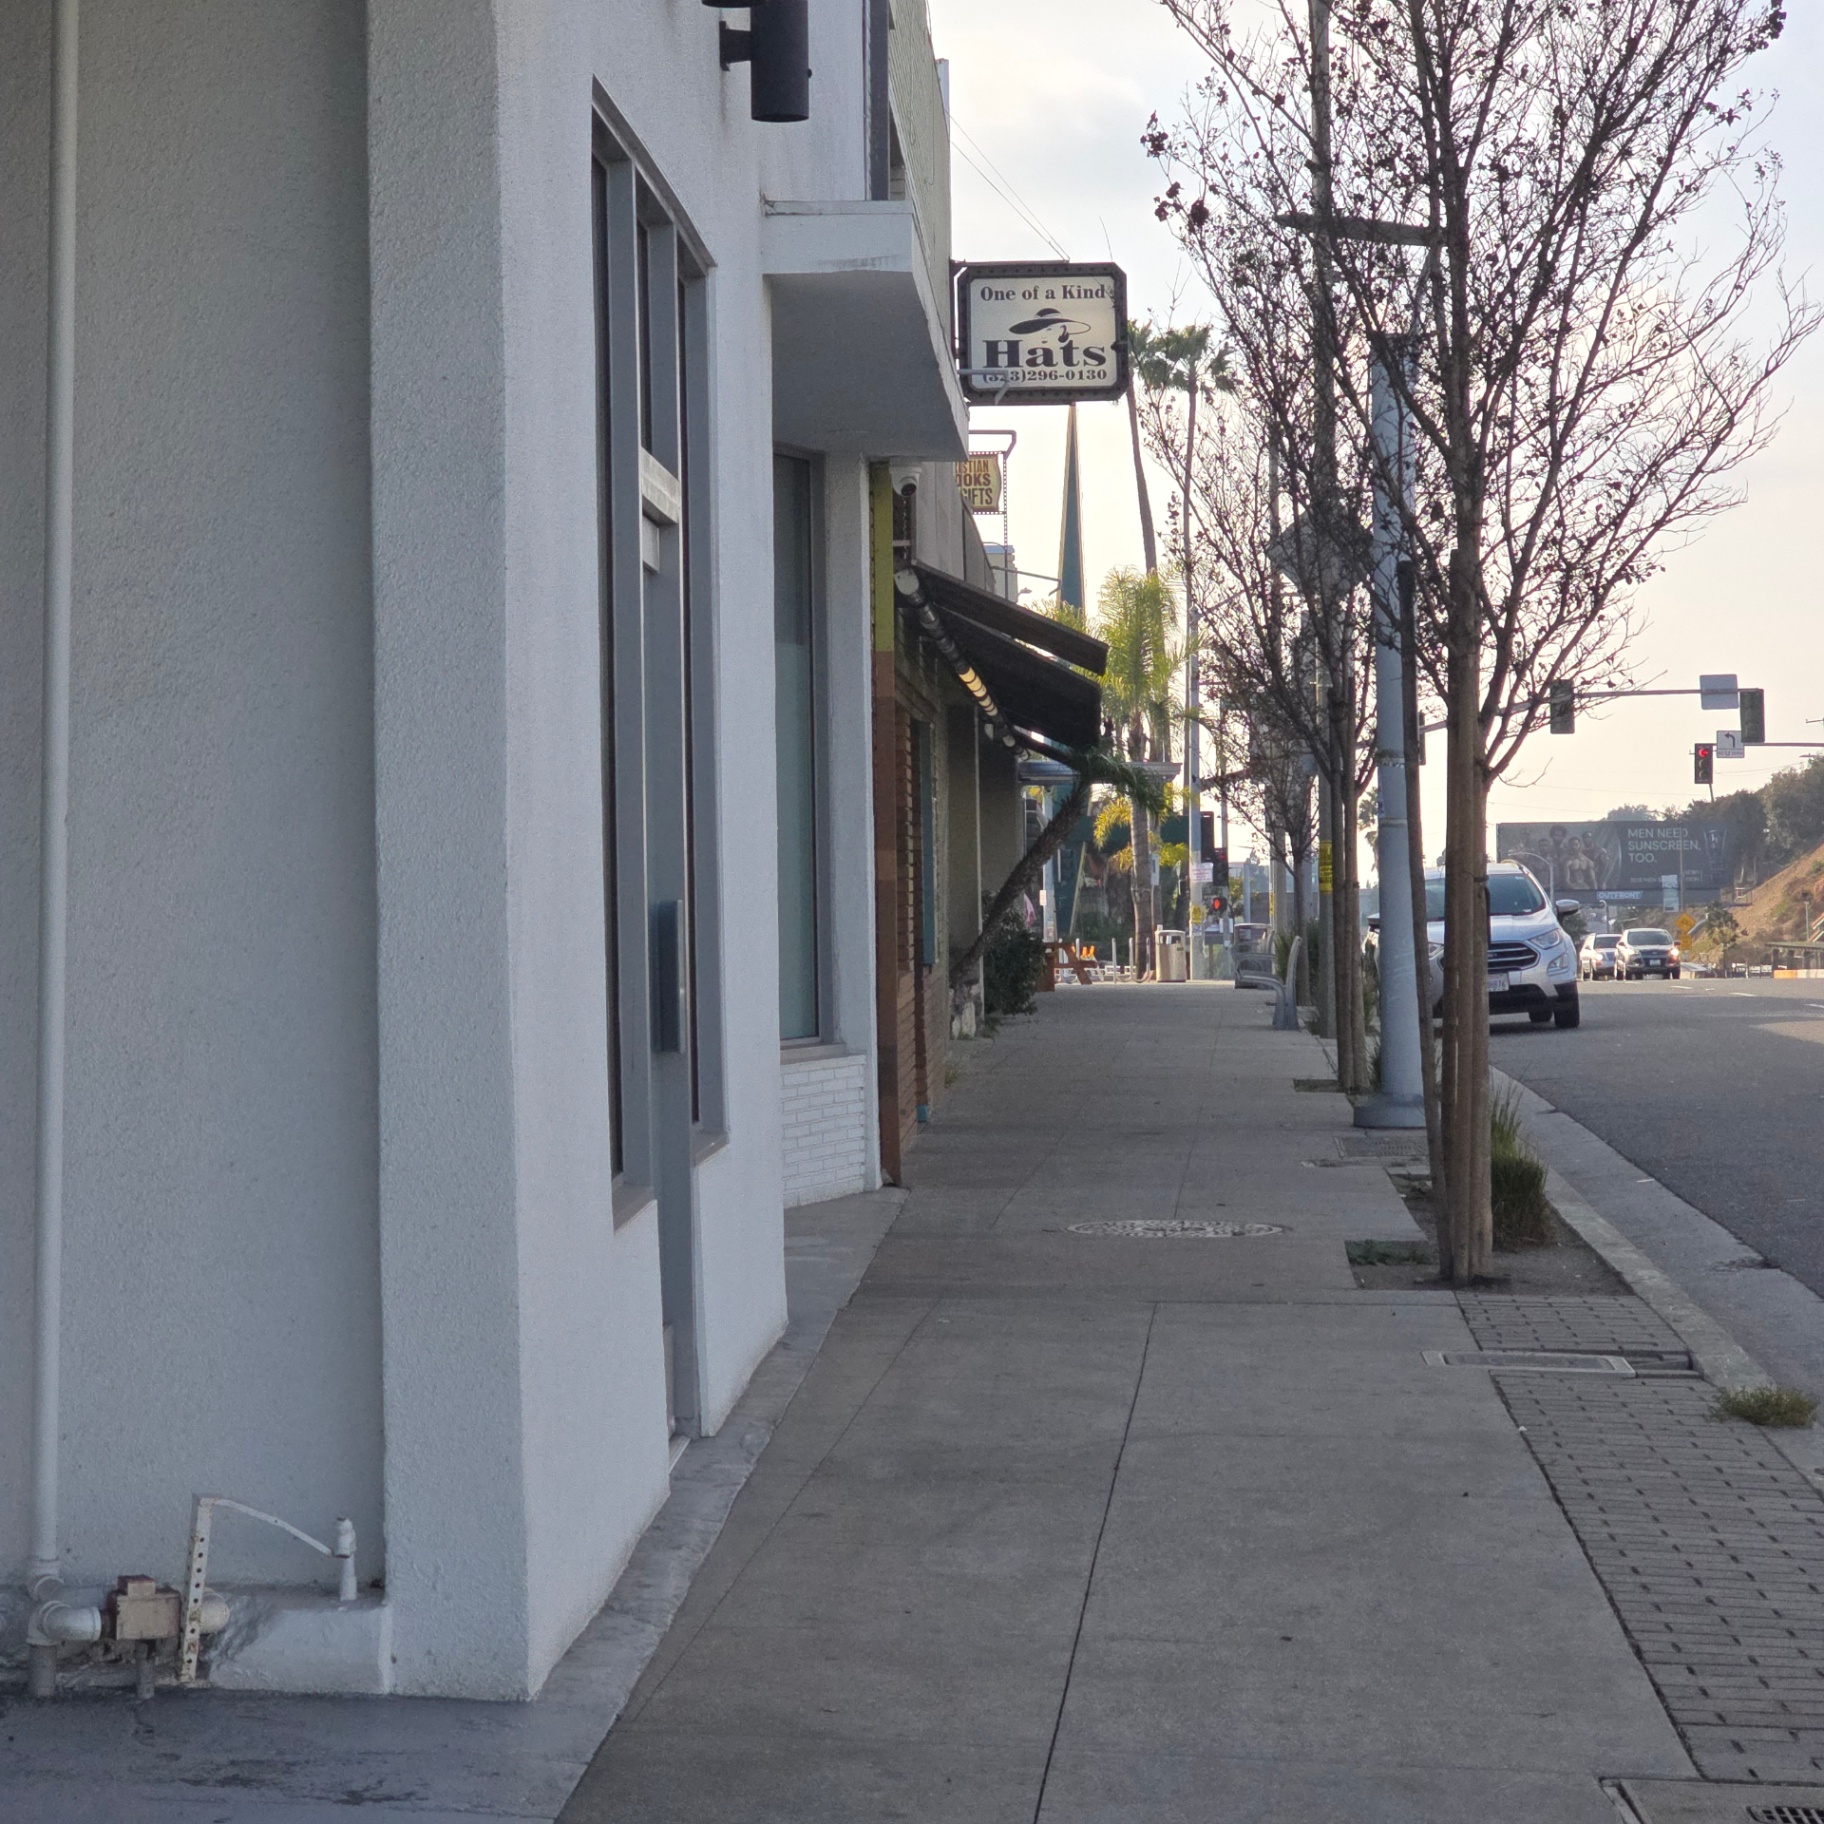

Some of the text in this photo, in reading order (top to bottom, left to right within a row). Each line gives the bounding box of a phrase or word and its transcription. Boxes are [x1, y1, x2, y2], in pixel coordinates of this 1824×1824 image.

[980, 284, 1105, 301] One of a Kind
[982, 339, 1107, 368] Hats
[955, 460, 989, 473] ISTIAN
[1627, 828, 1689, 838] MEN NEED
[1628, 852, 1657, 863] TOO.
[1598, 891, 1642, 900] OUTFRONT
